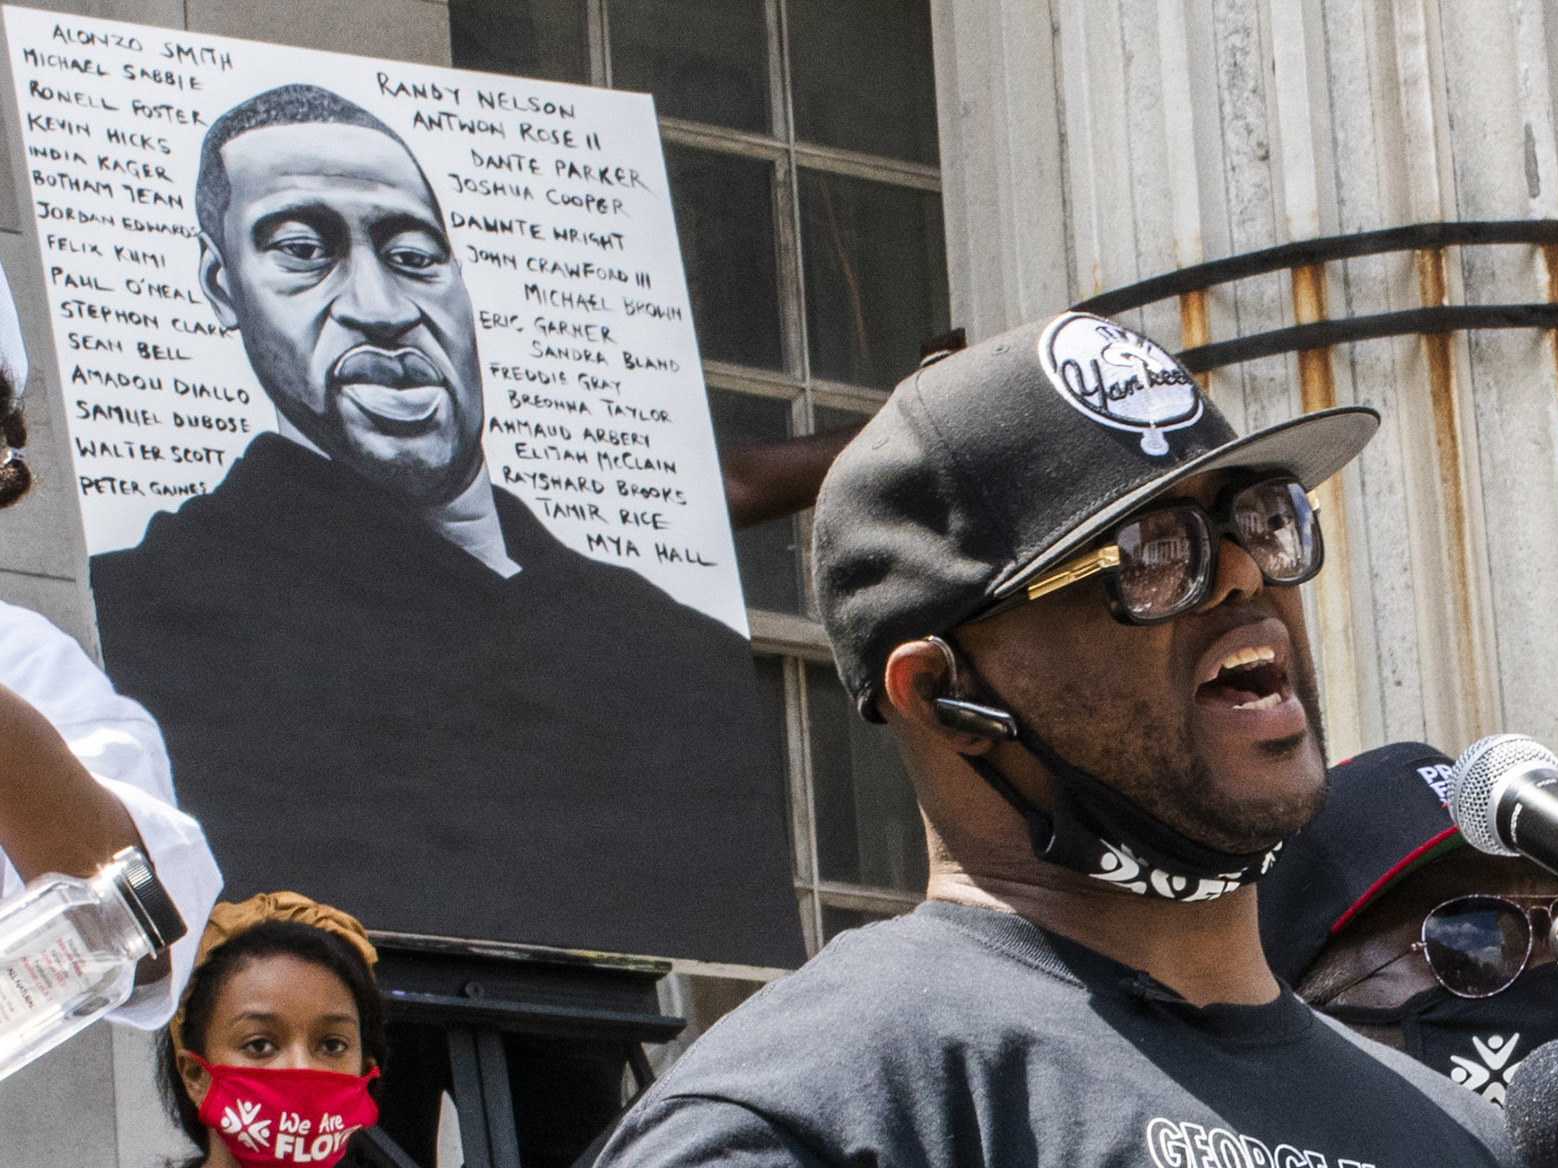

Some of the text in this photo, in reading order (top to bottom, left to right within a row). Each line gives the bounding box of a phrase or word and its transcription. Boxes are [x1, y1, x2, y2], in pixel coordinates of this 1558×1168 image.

[52, 24, 233, 70] ALONZO SMITH
[23, 48, 204, 91] MICHAEL SABBIE
[29, 79, 208, 127] RONELL FOSTER
[377, 72, 575, 118] RANDY NELSON
[27, 113, 172, 156] KEVIN HICKS
[413, 110, 504, 139] ANTWON
[520, 123, 578, 148] ROSE
[28, 145, 173, 184] INDIA KAGER
[471, 149, 650, 189] DANTE PARKER
[32, 170, 183, 210] BOTHAM JEAN
[448, 173, 630, 218] JOSHUA COOPER
[37, 201, 203, 239] JORDAN EDWARDS
[450, 212, 625, 250] DAUNTE WRIGHT
[47, 234, 165, 268] FELIX KUMI
[467, 245, 516, 270] JOHN
[526, 256, 628, 283] CRAWFORD
[51, 267, 114, 292] PAUL
[60, 300, 234, 340] STEPHON CLARK
[524, 284, 682, 321] MICHAEL BROWN
[480, 311, 617, 344] ERIC GARNER
[68, 333, 193, 360] SEAN BELL
[532, 341, 681, 372] SANDRA BLAND
[72, 365, 250, 405] AMADOU DIALLO
[490, 362, 621, 394] FREDDIE GRAY
[76, 401, 250, 434] SAMUEL DUBOSE
[507, 389, 672, 423] BREONNA TAYLOR
[489, 417, 650, 448] AHMAUD ARBERY
[75, 437, 225, 466] WALTER SCOTT
[515, 443, 588, 463] ELIJAH
[79, 476, 208, 496] PETER GAINES
[502, 467, 687, 505] RAYSHARD BROOKS
[535, 497, 671, 529] TAMIR RICE
[587, 534, 718, 567] MYA HALL
[279, 1112, 344, 1134] We Are
